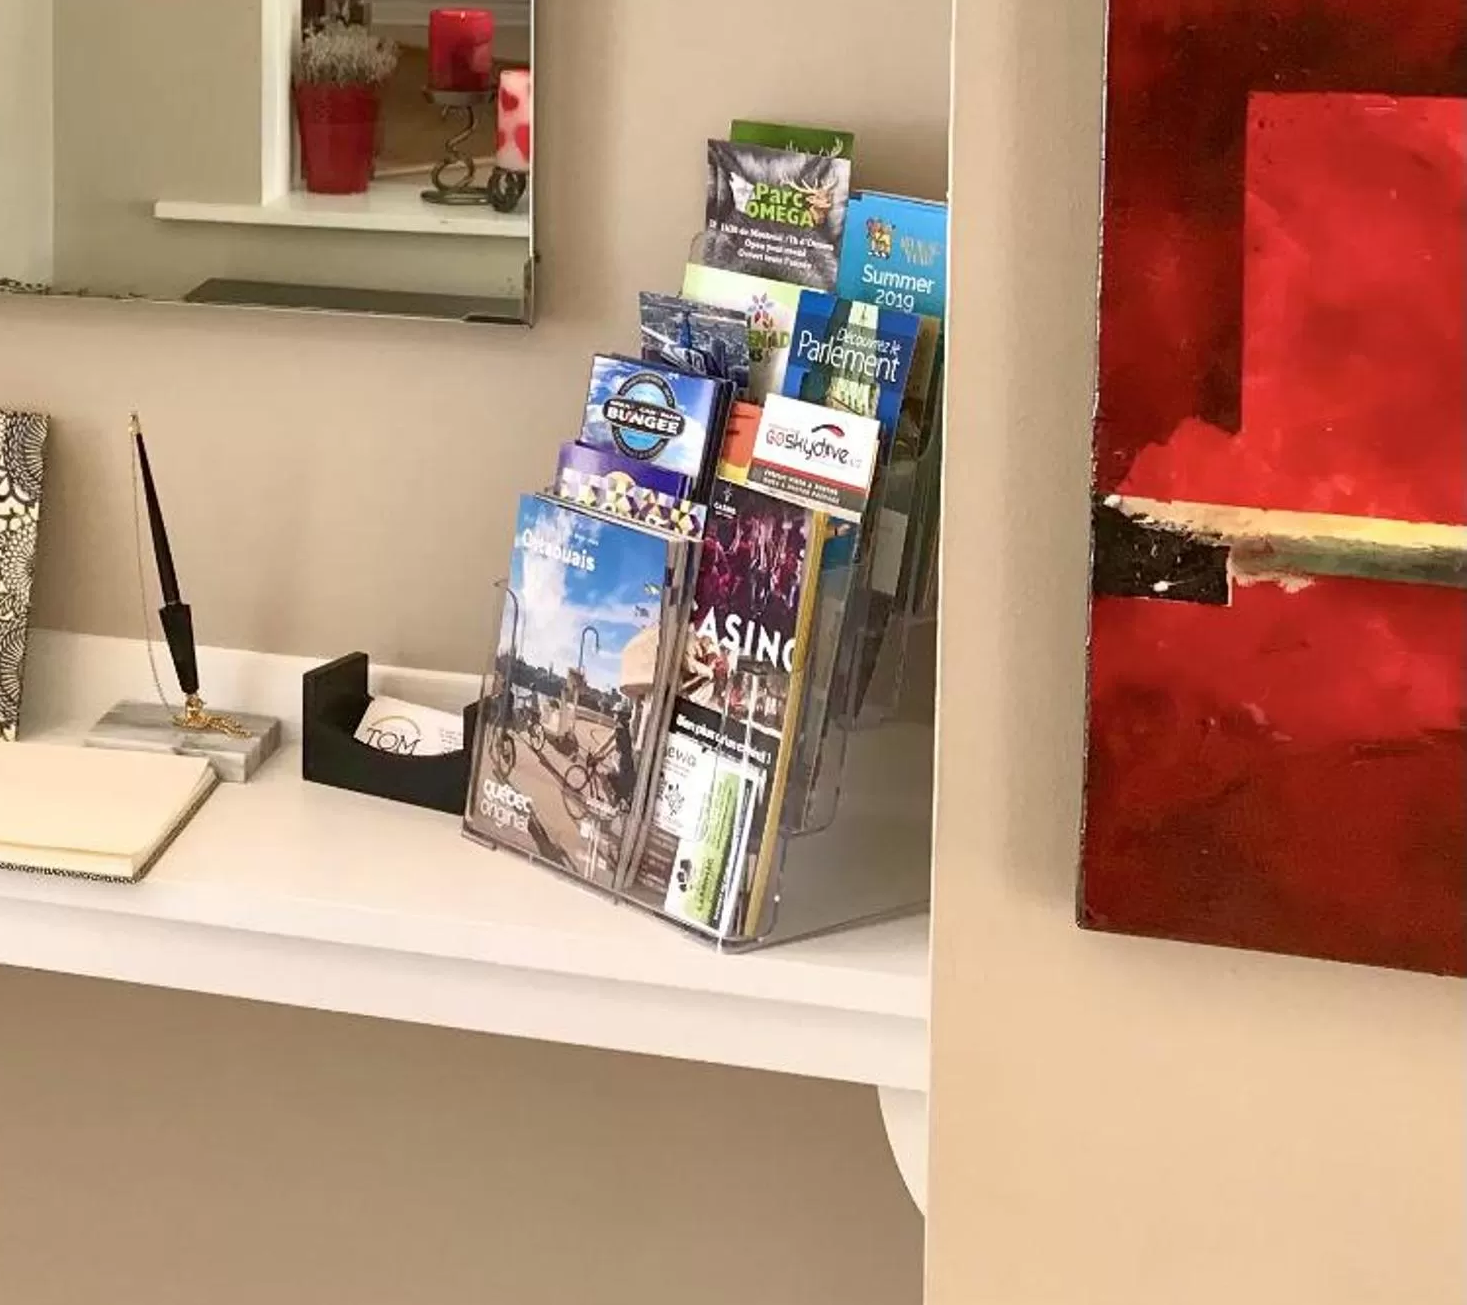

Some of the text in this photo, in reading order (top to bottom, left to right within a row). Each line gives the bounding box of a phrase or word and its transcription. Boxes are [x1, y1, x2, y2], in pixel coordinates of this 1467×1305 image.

[754, 182, 804, 207] Parc
[744, 201, 815, 227] OMEGA
[862, 263, 934, 294] Summer
[875, 288, 915, 313] 2019
[797, 329, 901, 382] Parlement
[607, 405, 680, 435] BUNGEE
[523, 528, 596, 572] Outaouais
[366, 727, 421, 756] TOM
